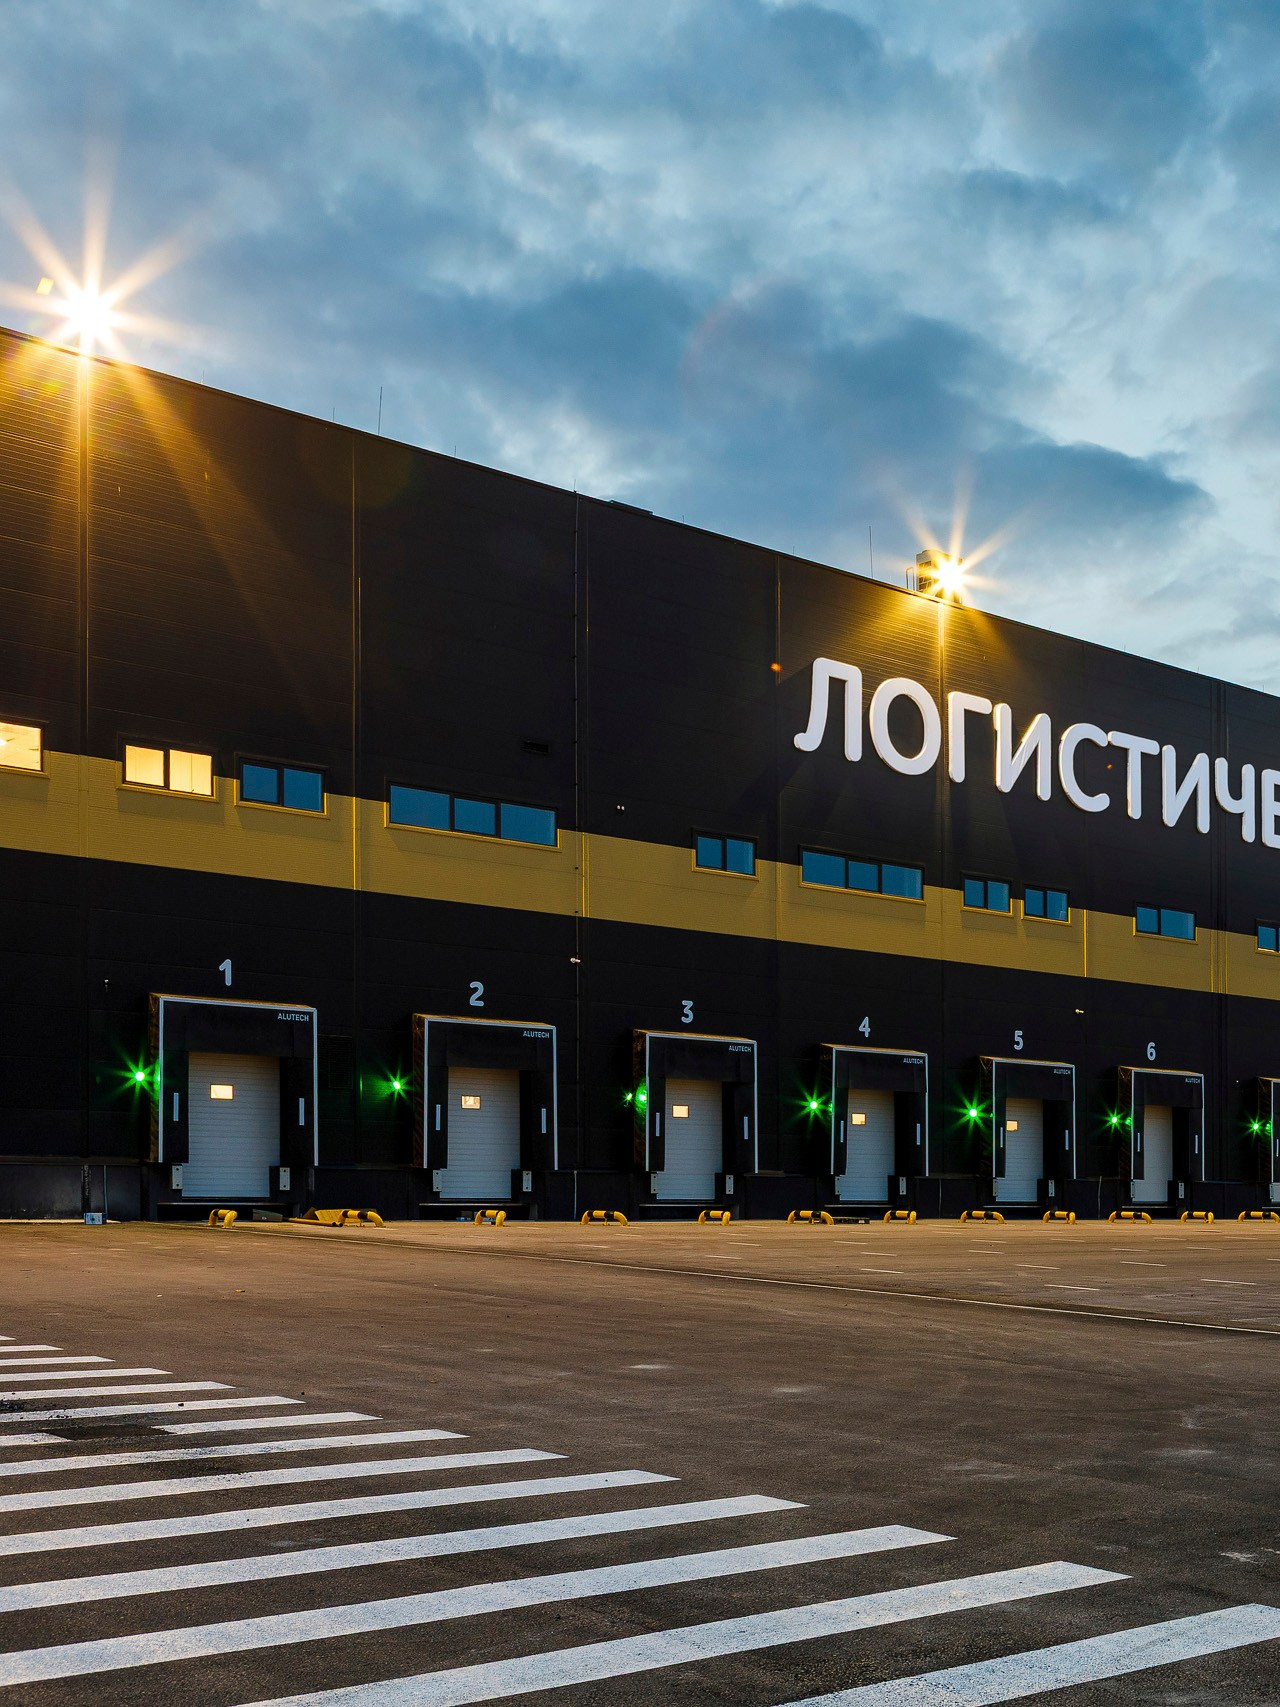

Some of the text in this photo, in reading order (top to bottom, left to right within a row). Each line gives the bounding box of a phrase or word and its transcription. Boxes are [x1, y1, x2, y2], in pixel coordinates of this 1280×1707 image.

[218, 958, 232, 987] 1
[469, 981, 485, 1007] 2
[277, 1012, 310, 1022] ALUTECH
[681, 999, 694, 1024] 3
[522, 1030, 550, 1039] ALUTECH
[858, 1016, 871, 1038] 4
[728, 1045, 752, 1053] ALUTECH
[1013, 1030, 1024, 1051] 5
[903, 1057, 924, 1065] ALUTECH
[1146, 1041, 1156, 1061] 6
